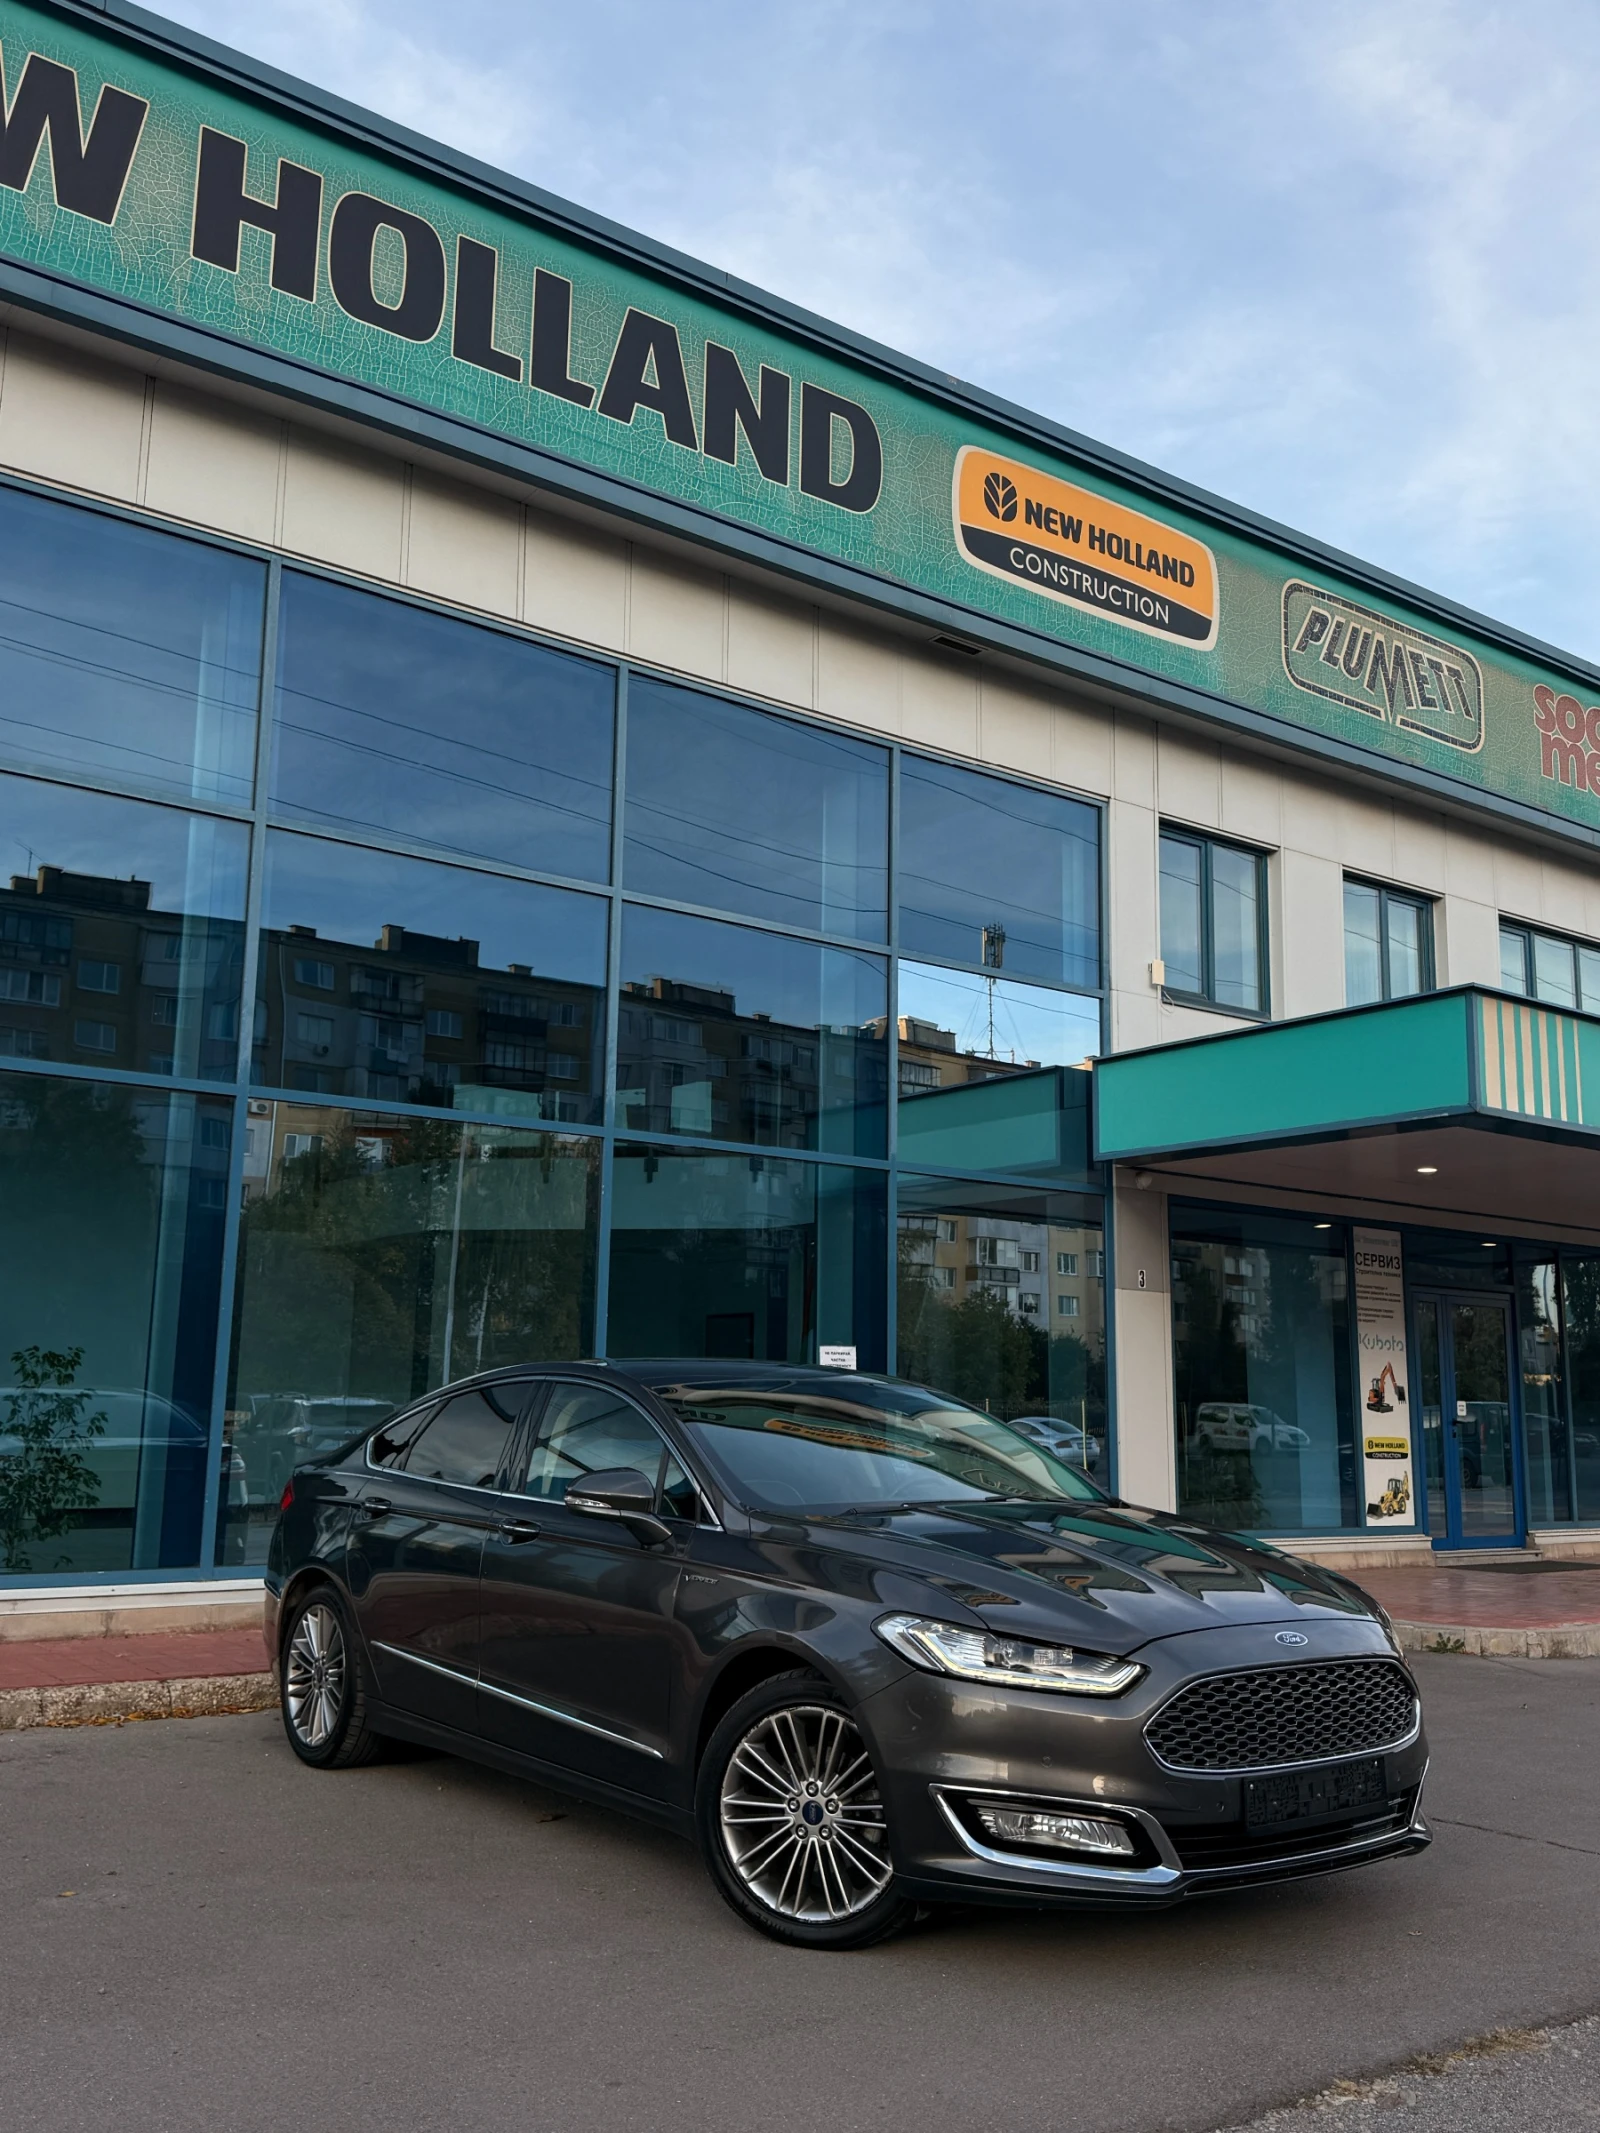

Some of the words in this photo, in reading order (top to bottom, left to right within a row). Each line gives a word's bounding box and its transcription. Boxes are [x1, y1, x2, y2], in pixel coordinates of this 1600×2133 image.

[190, 124, 883, 514] HOLLAND
[1024, 498, 1083, 544] NEW
[1088, 523, 1195, 588] HOLLAND
[1009, 547, 1169, 624] CONSTRUCTION
[1292, 605, 1475, 724] PLUMETT
[1139, 1270, 1145, 1288] 3
[1355, 1251, 1401, 1270] СЕРВИЗ
[1358, 1333, 1405, 1352] Kubota
